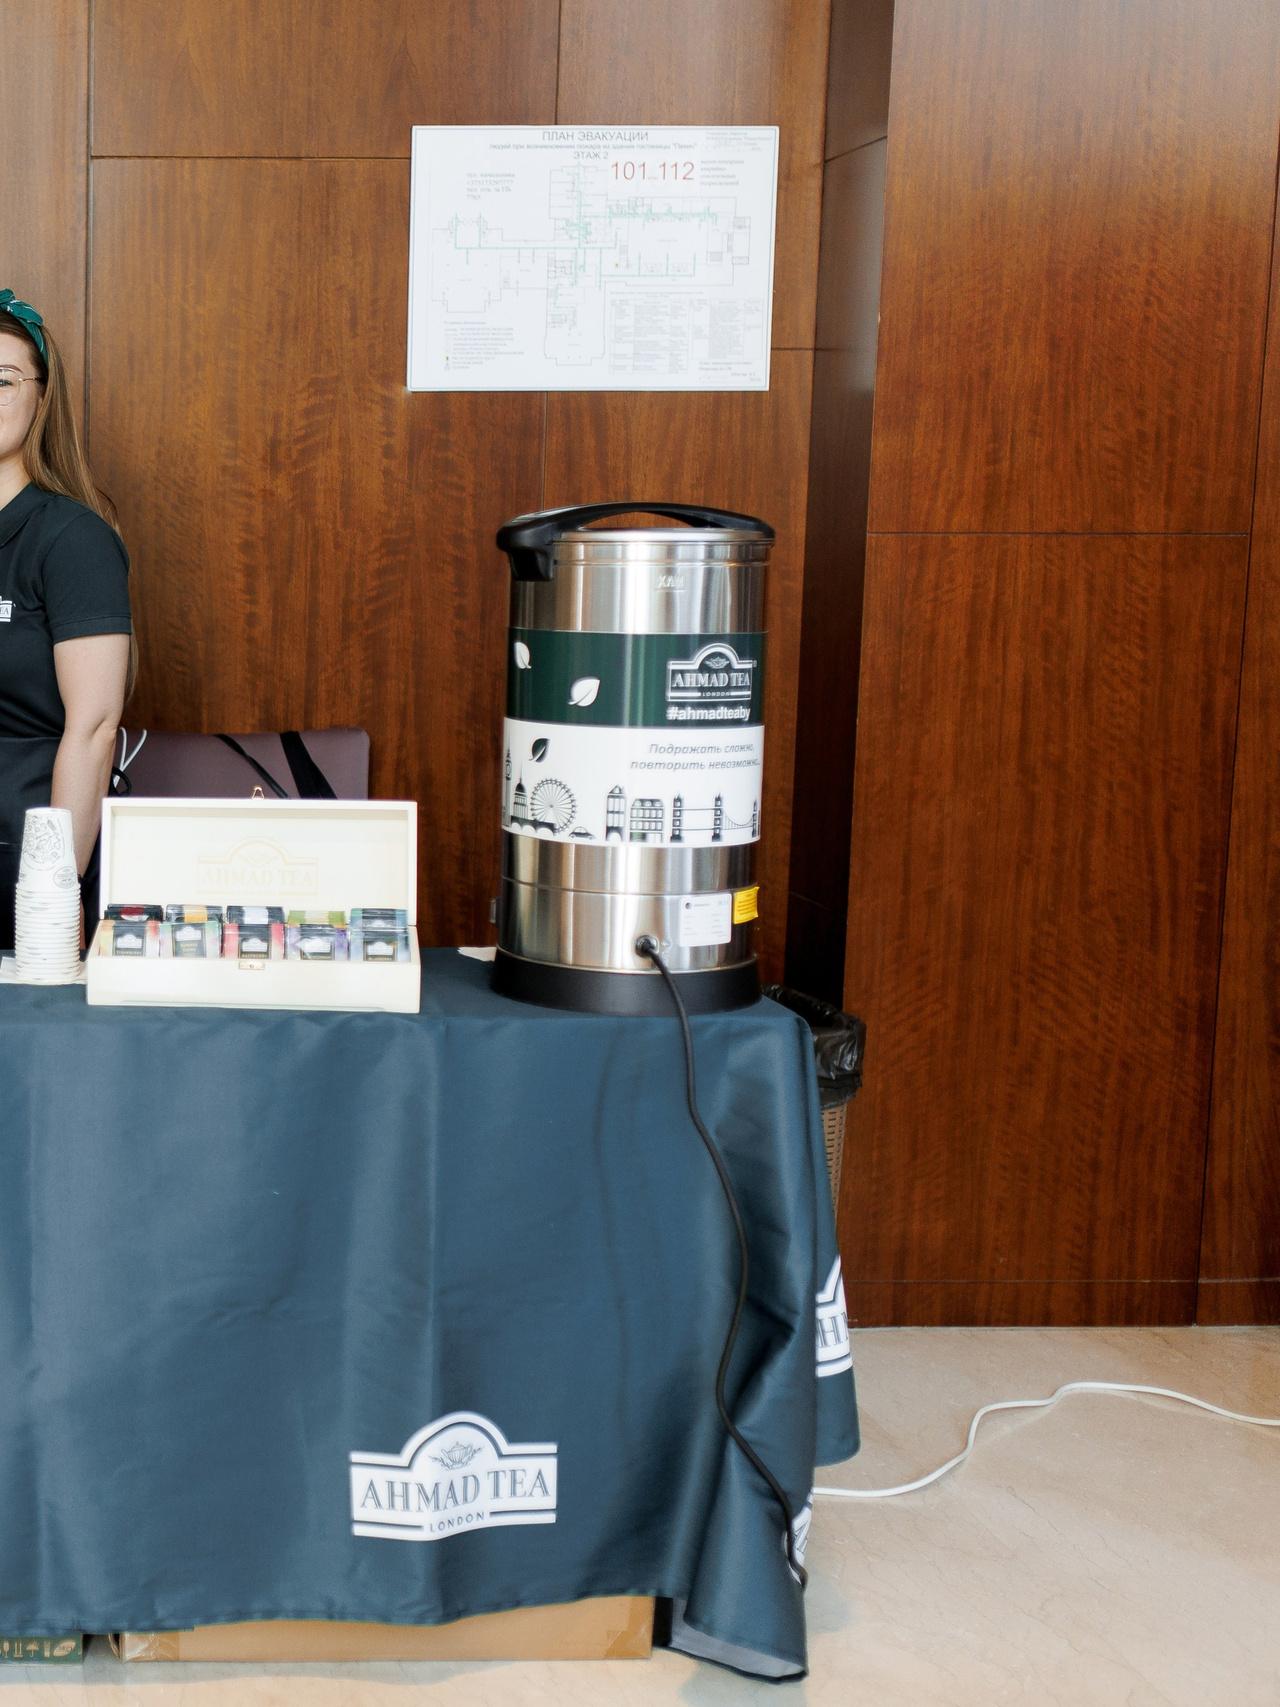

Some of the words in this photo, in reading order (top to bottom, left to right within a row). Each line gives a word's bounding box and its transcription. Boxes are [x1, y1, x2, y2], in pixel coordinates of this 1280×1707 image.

[542, 131, 574, 141] ПЛАН
[577, 131, 649, 142] ЭВАКУАЦИИ
[573, 151, 601, 160] ЭТАЖ
[603, 151, 609, 160] 2
[611, 161, 646, 180] 101
[659, 161, 695, 180] 112
[672, 671, 729, 687] AHMAD
[730, 672, 751, 687] TEA
[666, 706, 751, 721] #ahmadteaby
[649, 743, 722, 756] Подражать
[630, 760, 706, 772] повторить
[201, 867, 273, 888] AHMAD
[277, 868, 314, 888] TEA
[359, 1473, 482, 1514] AHMAD
[487, 1467, 550, 1500] TEA
[429, 1511, 486, 1534] LONDON
